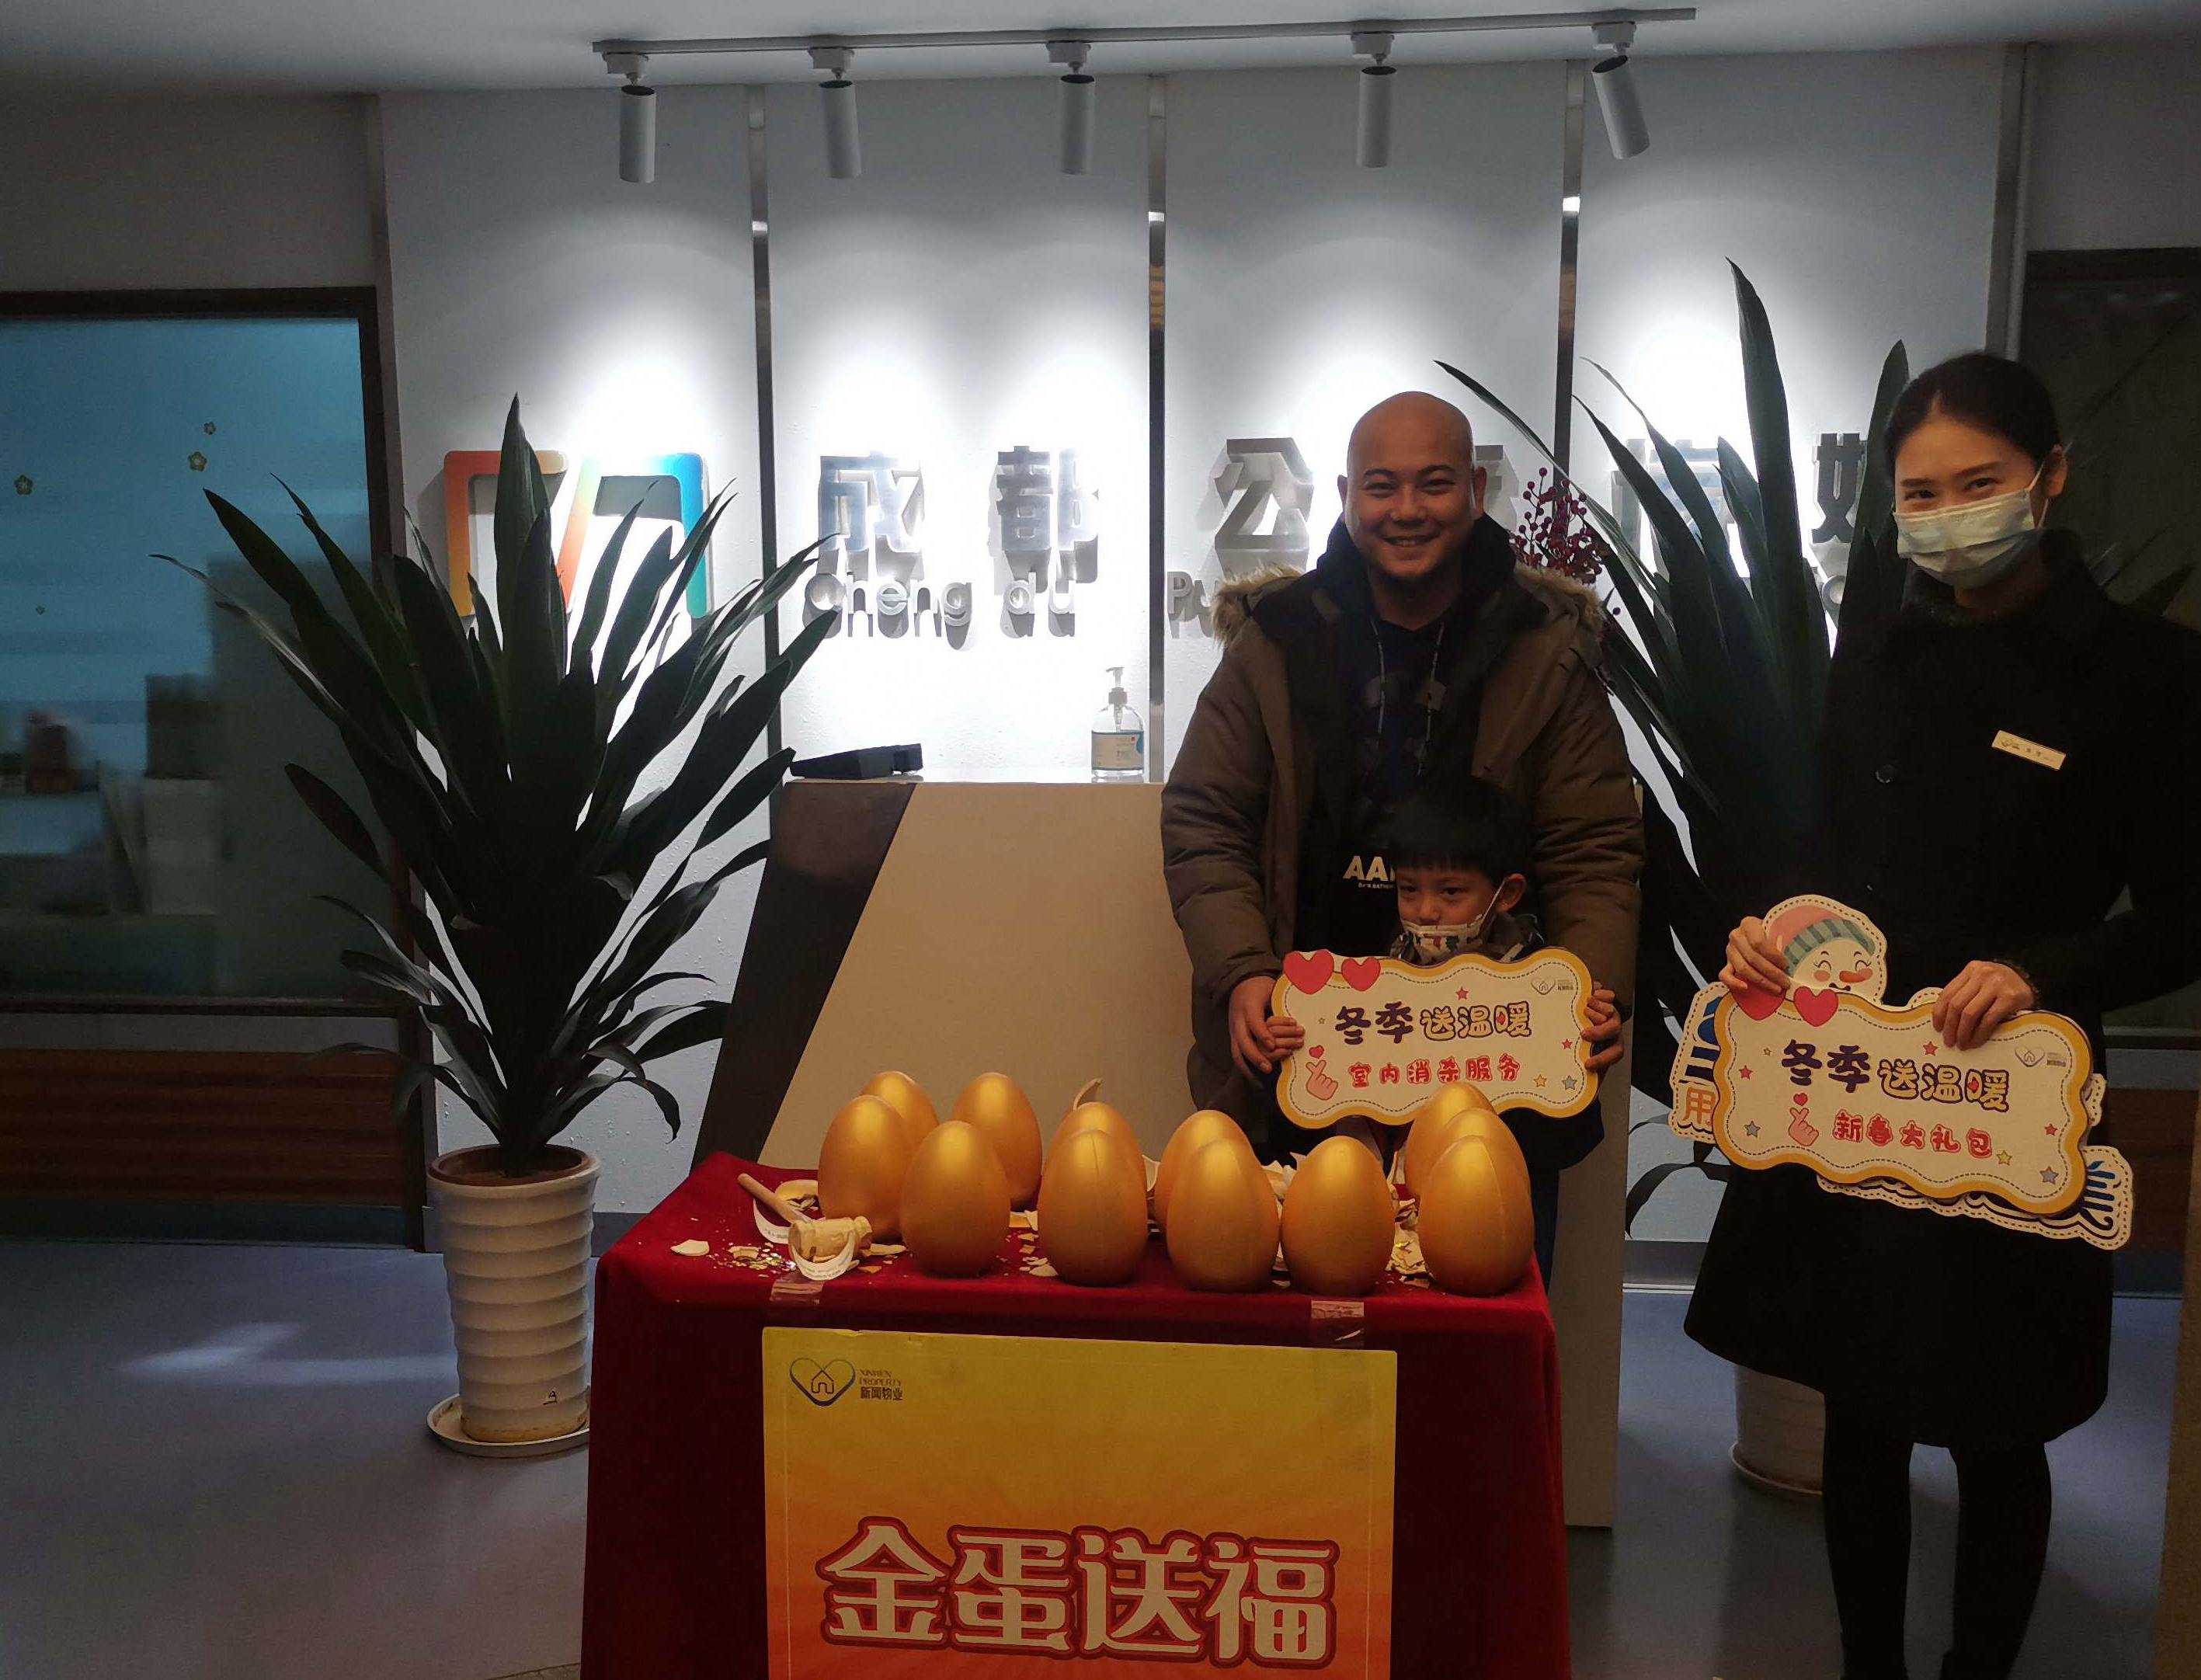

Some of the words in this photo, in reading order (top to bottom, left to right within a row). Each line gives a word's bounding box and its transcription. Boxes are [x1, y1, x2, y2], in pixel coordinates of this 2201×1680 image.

[1342, 855, 1396, 881] AA
[1335, 1001, 1532, 1045] 冬季送温暖
[1348, 1052, 1521, 1089] 室内消杀服务
[1781, 1039, 2010, 1113] 冬季送温暖
[1834, 1109, 1993, 1159] 新春大礼包
[820, 1522, 1334, 1664] 金蛋送福
